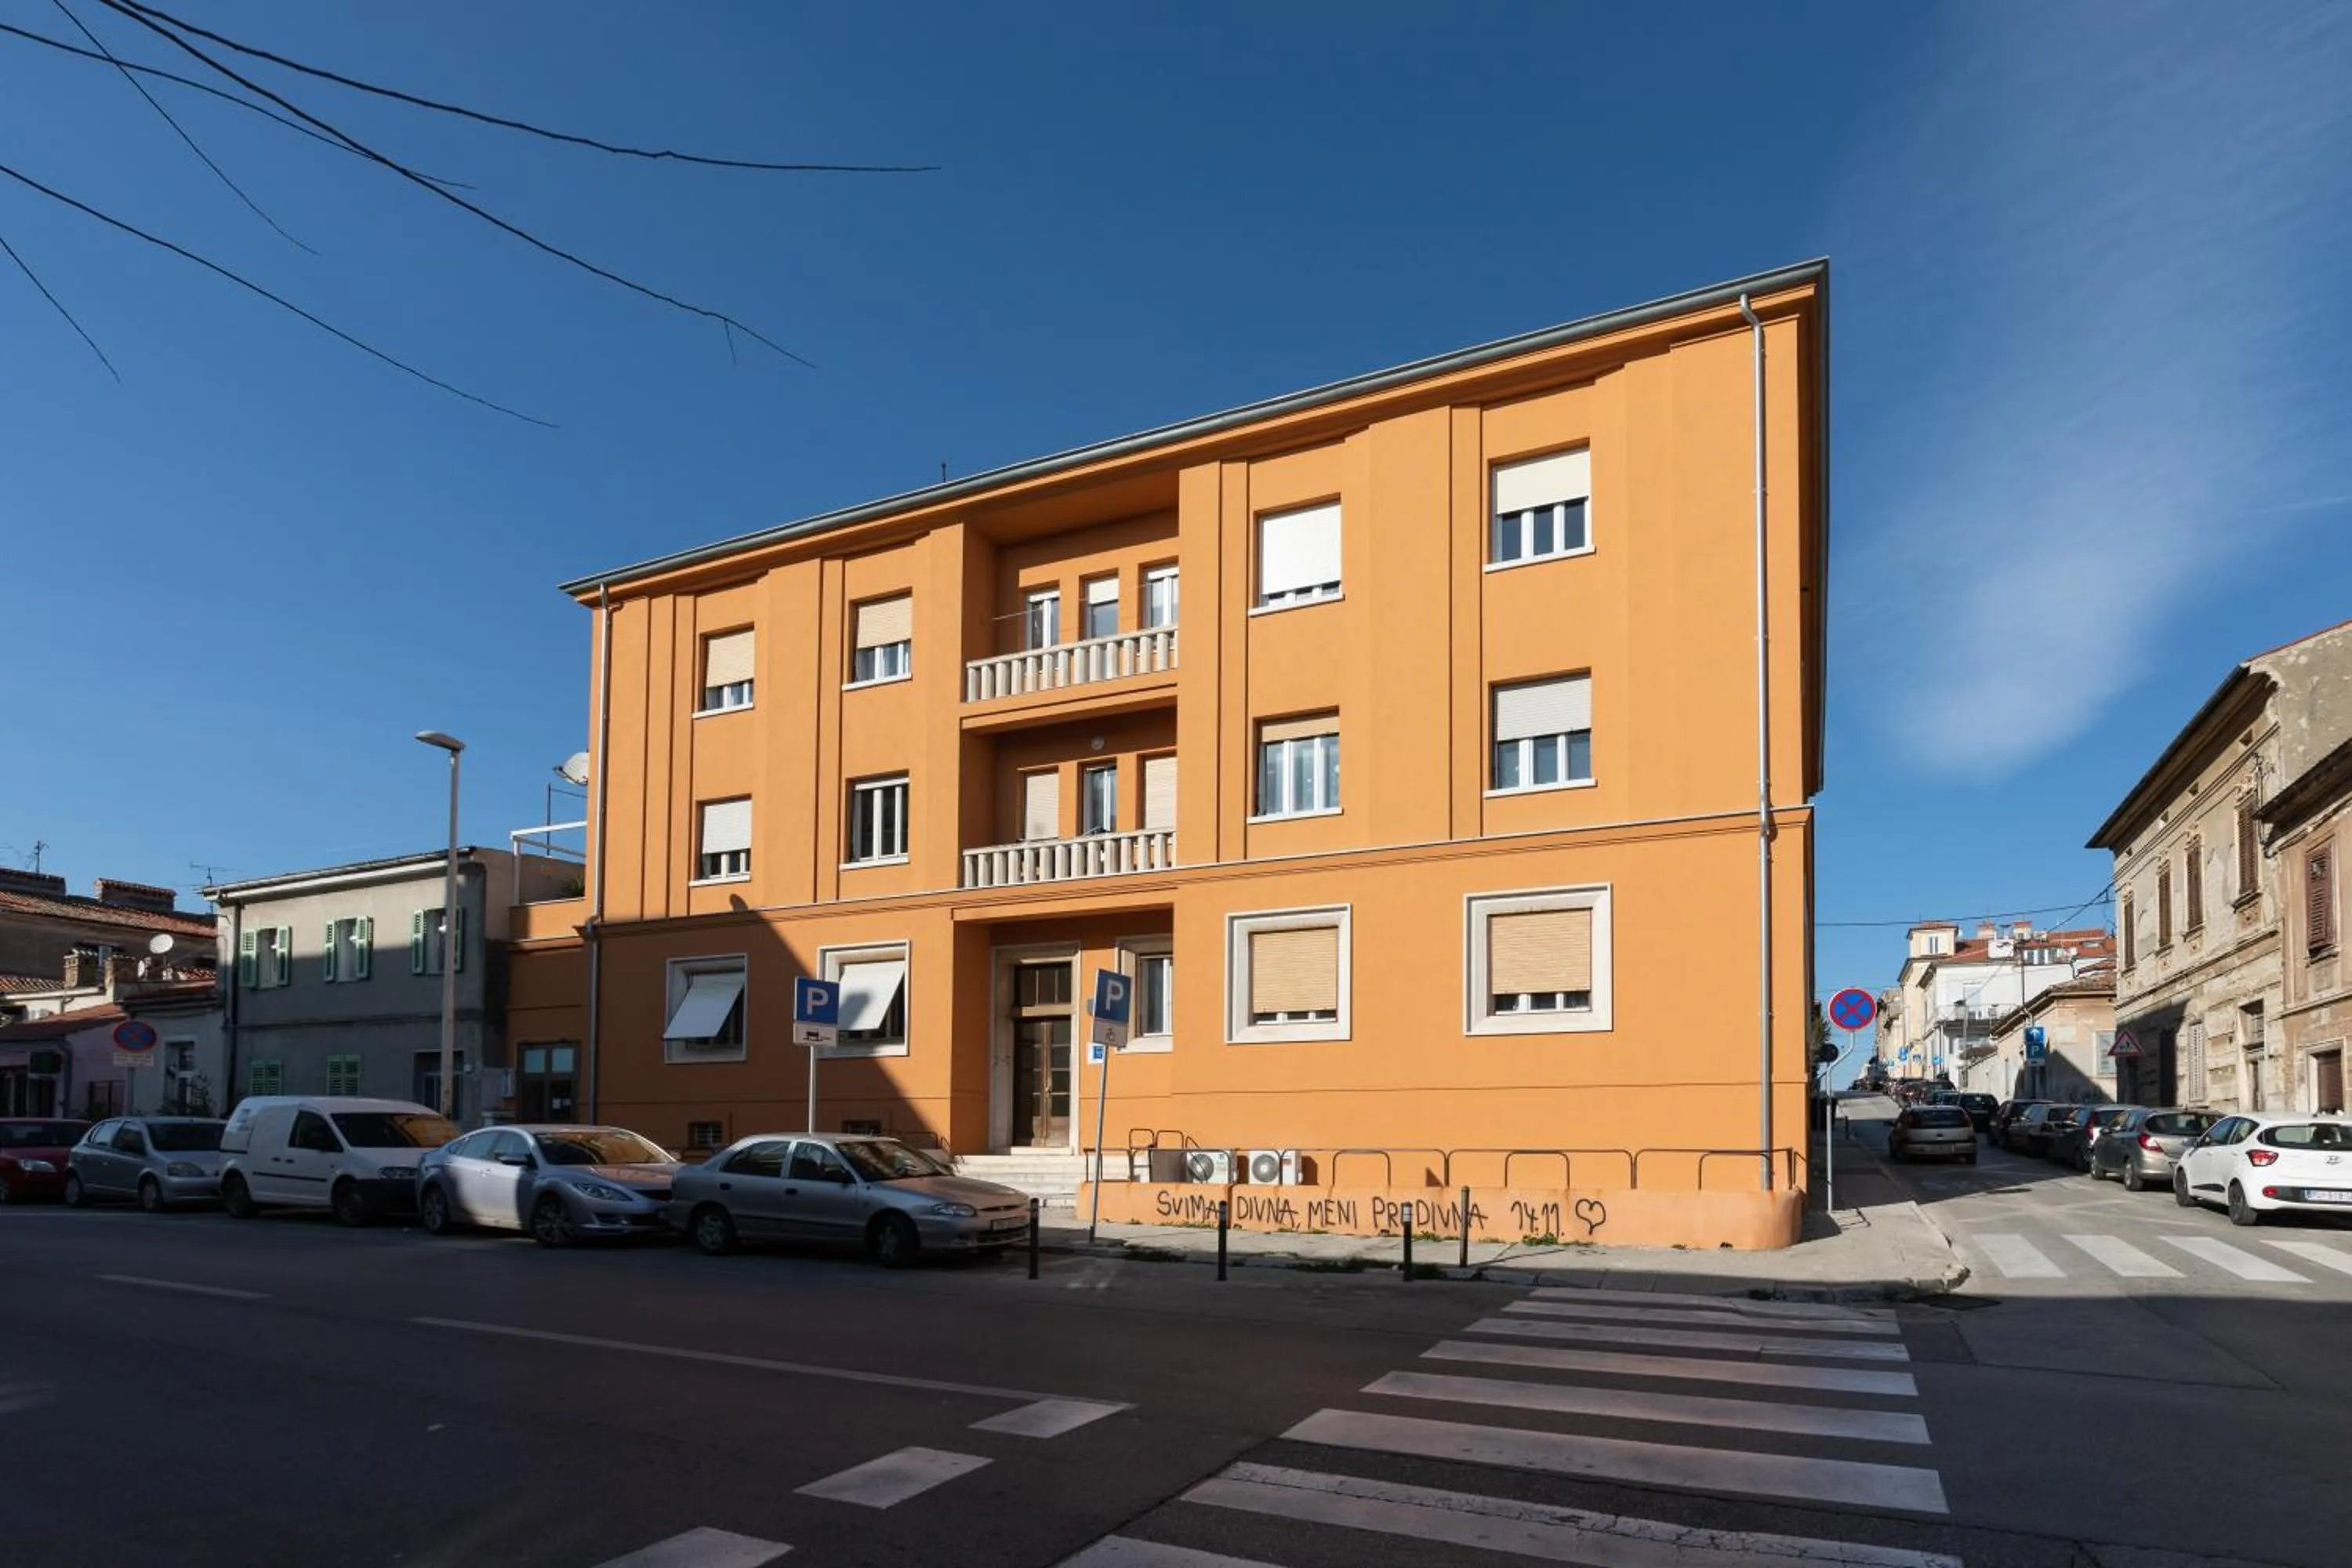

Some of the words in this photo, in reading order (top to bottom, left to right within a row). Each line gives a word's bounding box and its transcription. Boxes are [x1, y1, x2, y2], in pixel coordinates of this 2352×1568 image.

[806, 986, 829, 1015] P
[1105, 978, 1124, 1011] P
[2032, 1046, 2040, 1056] P
[1156, 1190, 1220, 1224] SVIMA
[1308, 1199, 1357, 1230] MENI
